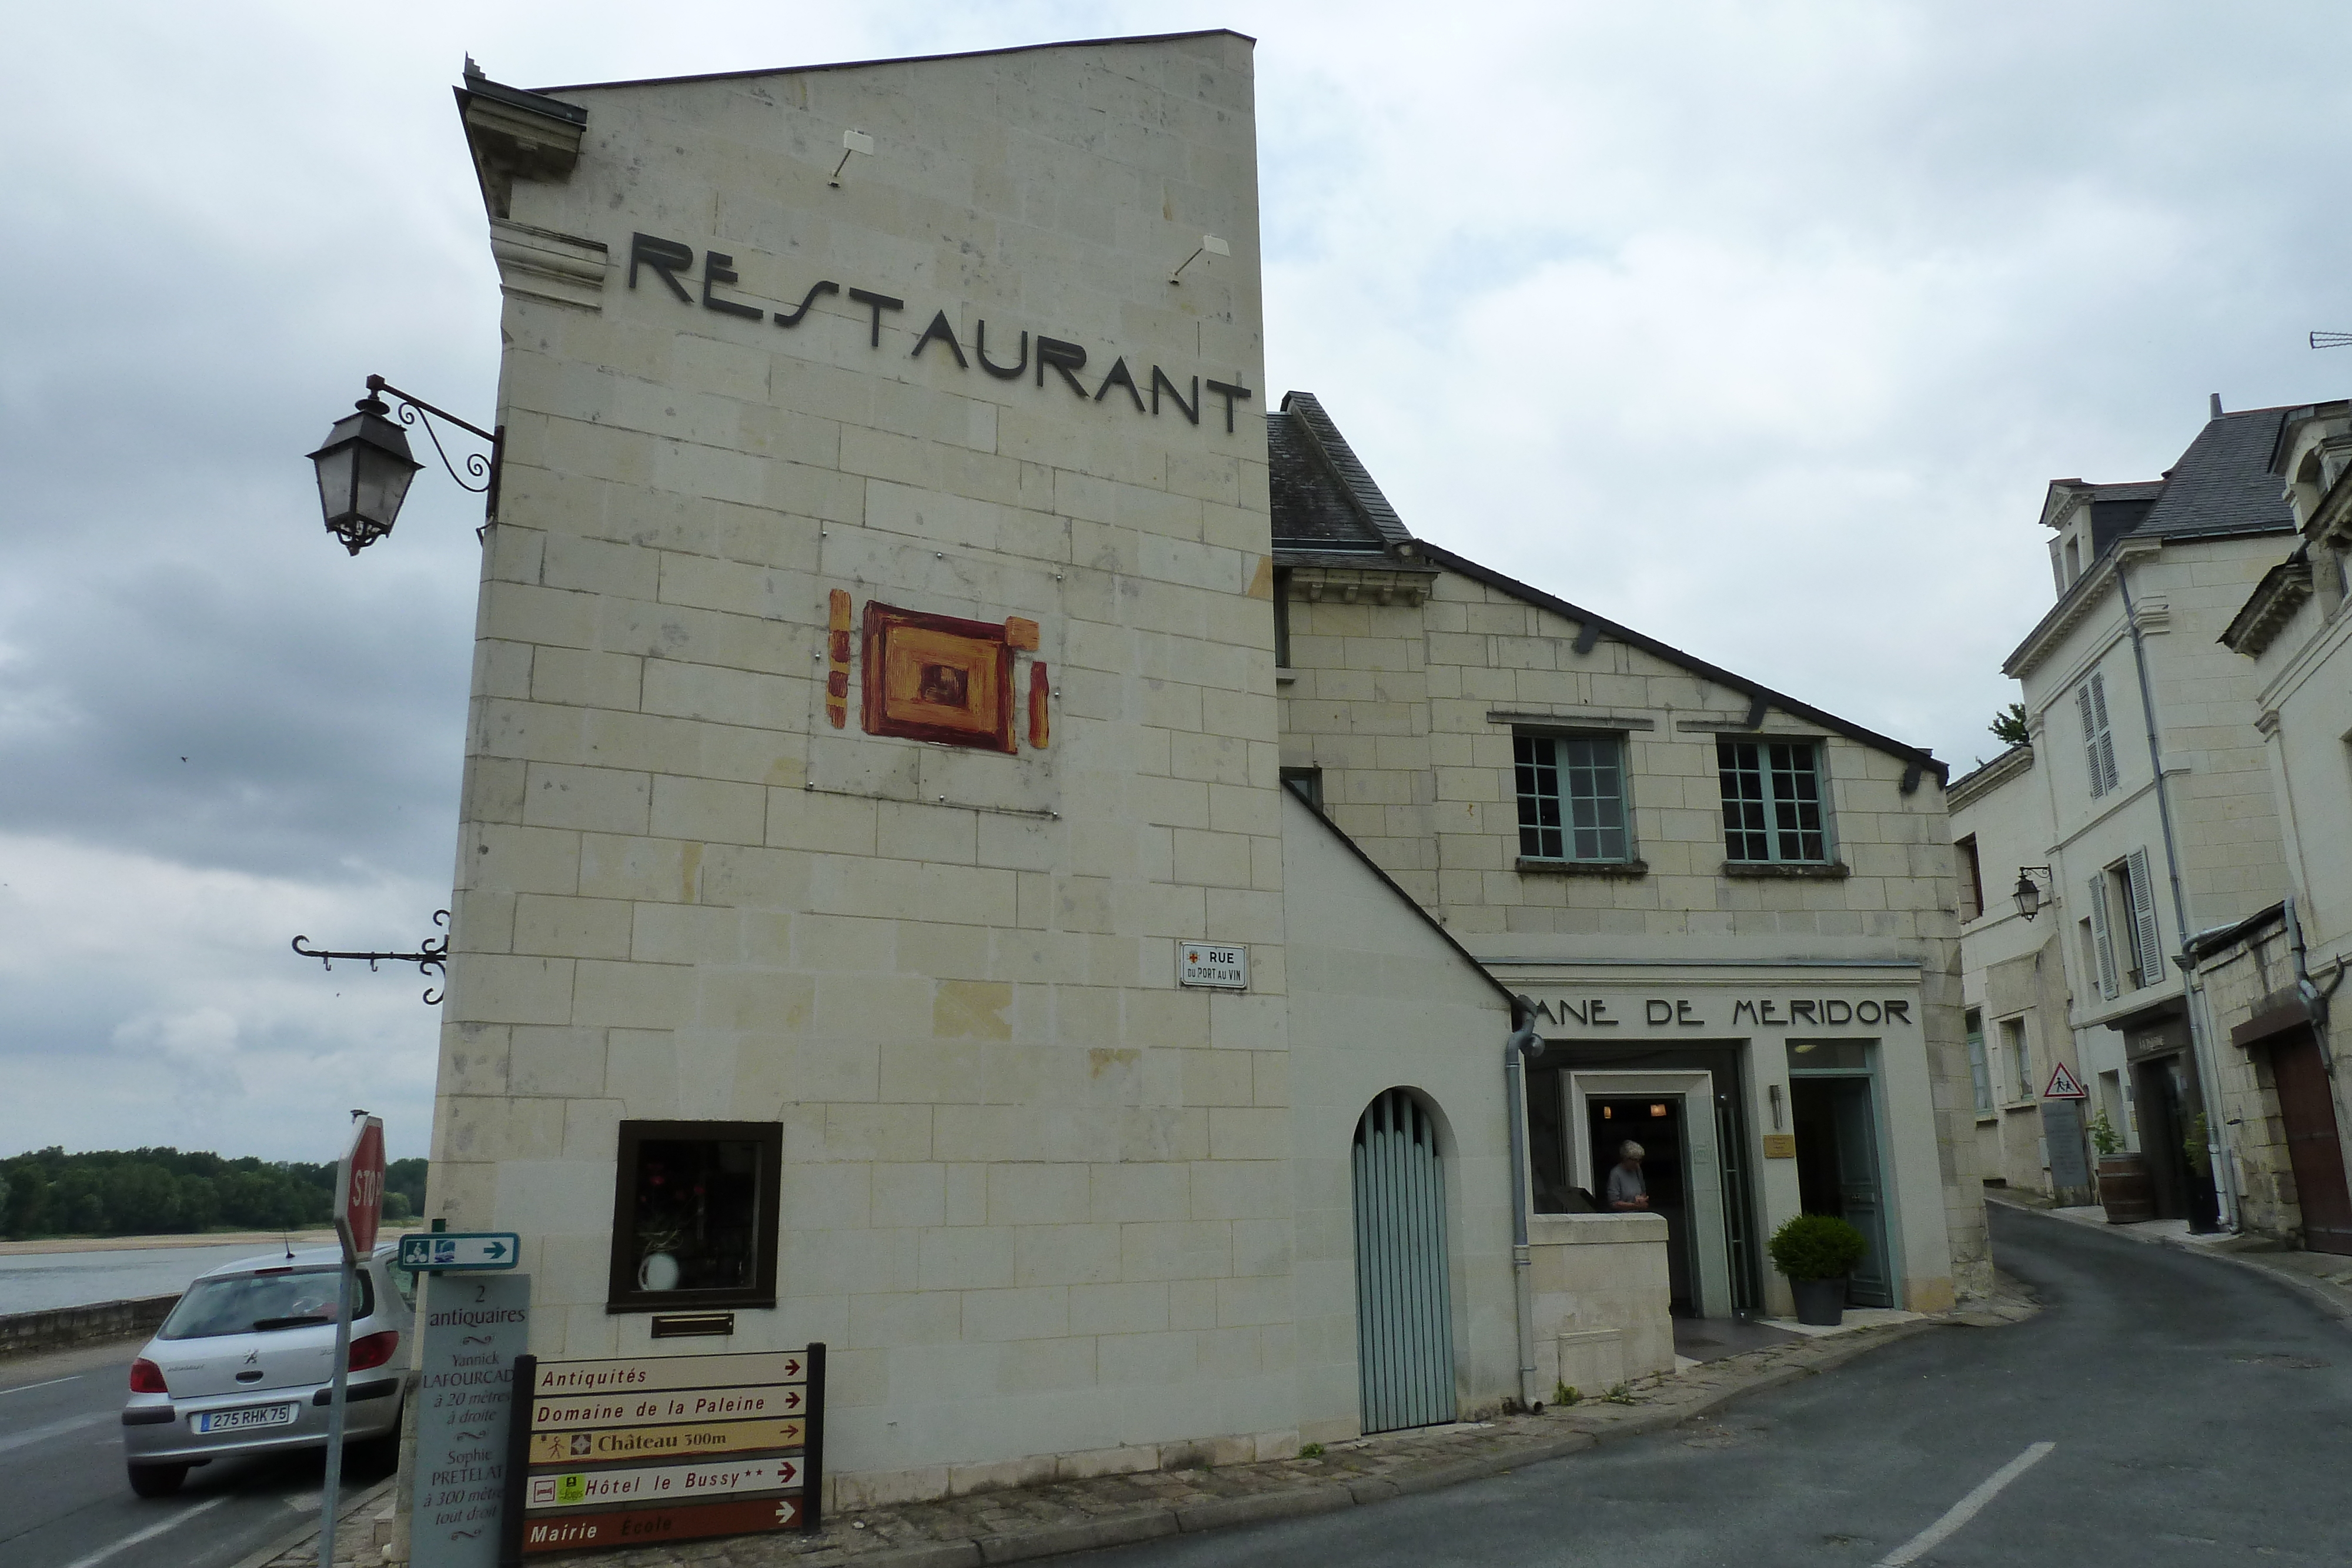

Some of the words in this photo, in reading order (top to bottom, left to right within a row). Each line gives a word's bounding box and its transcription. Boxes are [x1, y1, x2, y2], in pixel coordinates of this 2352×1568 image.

[629, 232, 1251, 433] RESTAURANT
[1210, 951, 1234, 964] RUE
[1188, 968, 1196, 978] DU
[1198, 967, 1216, 979] PORT
[1217, 970, 1227, 980] AU
[1228, 969, 1241, 981] VIN
[1646, 999, 1705, 1025] DE
[1733, 999, 1912, 1025] MERIDOR
[353, 1169, 382, 1207] STOP
[475, 1285, 485, 1302] 2
[430, 1307, 526, 1328] antiquaires
[452, 1351, 500, 1368] Yannick
[542, 1367, 646, 1388] Antiquités
[434, 1395, 443, 1408] à
[445, 1392, 466, 1407] 20
[537, 1404, 624, 1422] Domaine
[636, 1402, 657, 1417] de
[668, 1400, 684, 1415] la
[695, 1396, 764, 1414] Paleine
[213, 1412, 239, 1428] 275
[242, 1408, 268, 1425] RHK
[271, 1406, 287, 1421] 75
[446, 1410, 456, 1425] à
[459, 1409, 497, 1423] droite
[598, 1433, 678, 1452] Château
[446, 1447, 493, 1468] Sophie
[585, 1477, 640, 1496] Hôtel
[654, 1475, 671, 1490] le
[423, 1493, 432, 1507] à
[436, 1489, 466, 1506] 300
[436, 1509, 463, 1526] tout
[466, 1505, 497, 1522] droit
[530, 1522, 598, 1543] Mairie
[621, 1514, 672, 1536] École
